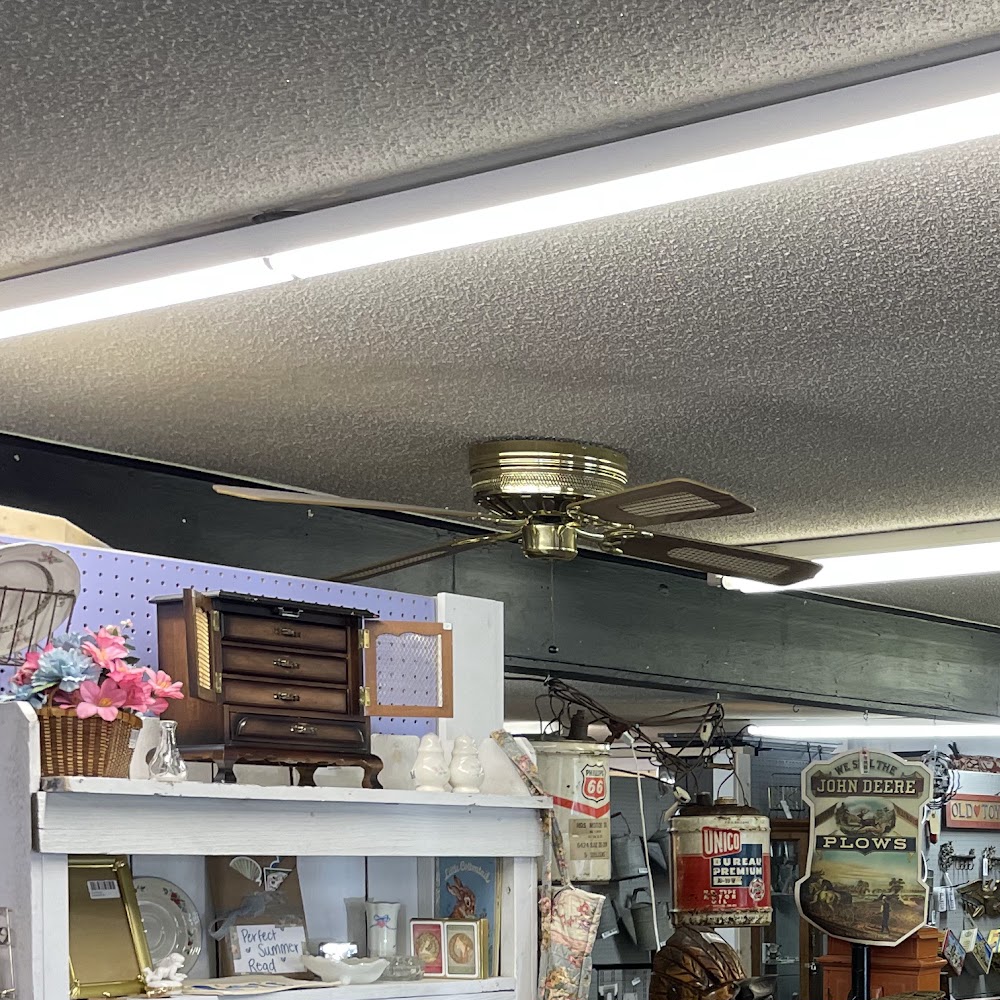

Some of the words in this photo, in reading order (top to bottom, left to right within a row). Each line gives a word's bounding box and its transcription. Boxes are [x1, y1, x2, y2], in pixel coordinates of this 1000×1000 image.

[835, 763, 851, 775] WE
[852, 759, 876, 770] SL
[876, 760, 898, 775] THE
[587, 780, 603, 794] 66
[817, 779, 859, 793] JOHN
[862, 779, 916, 794] DEERE
[951, 802, 973, 818] OLD
[703, 829, 740, 855] UNICO
[823, 837, 907, 849] PLOWS
[713, 858, 762, 866] BUREAU
[713, 867, 762, 876] PREMIUM
[241, 928, 276, 943] Perfect
[257, 943, 299, 958] Summer
[248, 958, 277, 973] Read
